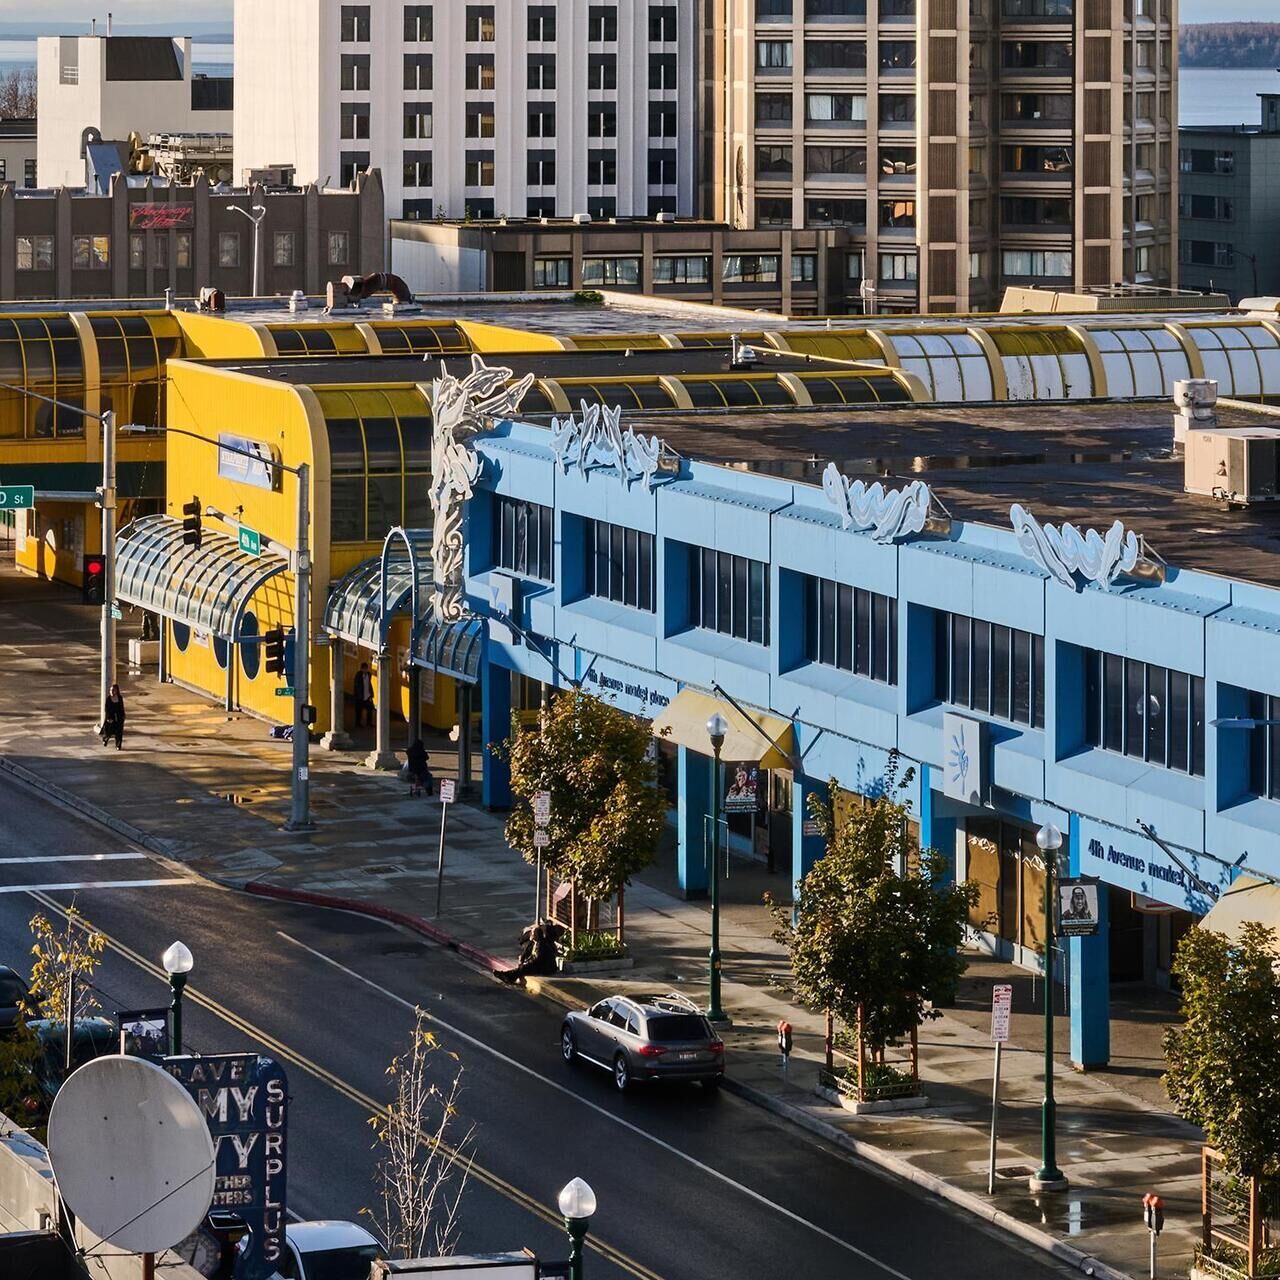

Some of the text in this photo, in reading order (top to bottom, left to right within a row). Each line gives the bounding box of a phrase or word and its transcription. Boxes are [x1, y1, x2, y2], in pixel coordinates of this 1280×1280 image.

[14, 494, 24, 505] St
[1088, 838, 1104, 860] 4th
[1107, 844, 1145, 873] Avenue
[1148, 862, 1185, 888] market
[263, 1079, 285, 1262] SURPLUS
